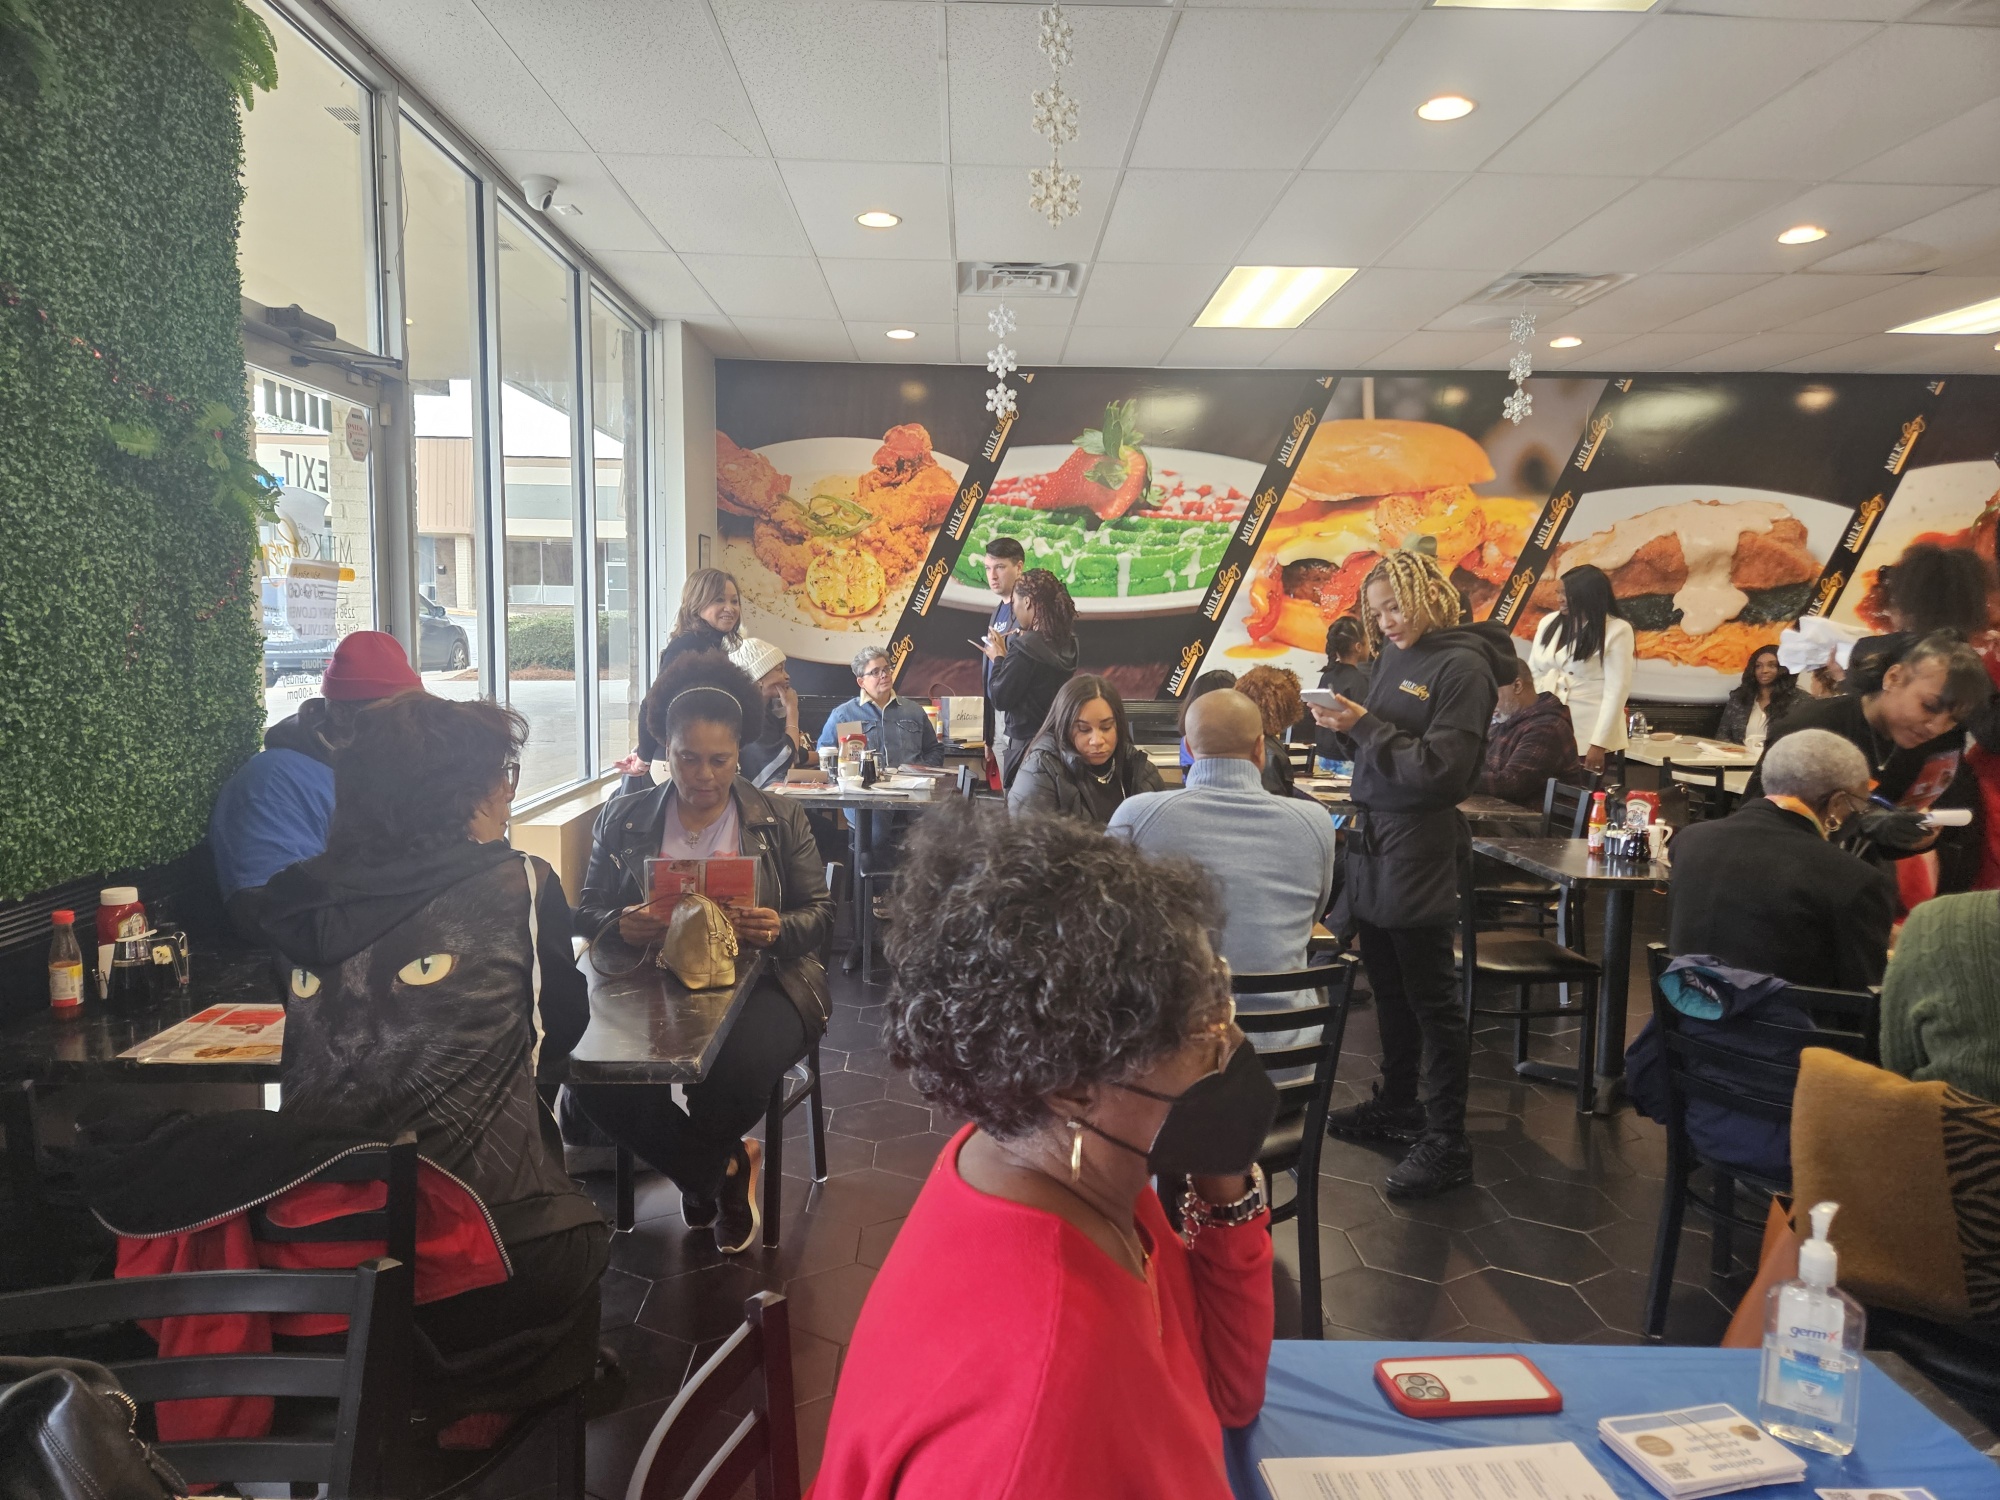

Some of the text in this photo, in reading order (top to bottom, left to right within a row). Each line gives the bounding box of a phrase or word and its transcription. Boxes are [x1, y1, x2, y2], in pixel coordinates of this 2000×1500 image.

[982, 430, 1001, 460] MILK
[1277, 436, 1298, 466] MILK
[1574, 440, 1594, 469] MILK
[1884, 441, 1905, 473] MILK
[945, 509, 965, 538] MILK
[1239, 514, 1260, 544] MILK
[1534, 518, 1554, 548] MILK
[1844, 521, 1865, 551] MILK
[911, 584, 930, 613] MILK
[1203, 589, 1224, 619] MILK
[1496, 594, 1516, 624] MILK
[1807, 598, 1823, 617] ILK
[1166, 665, 1187, 695] MILK
